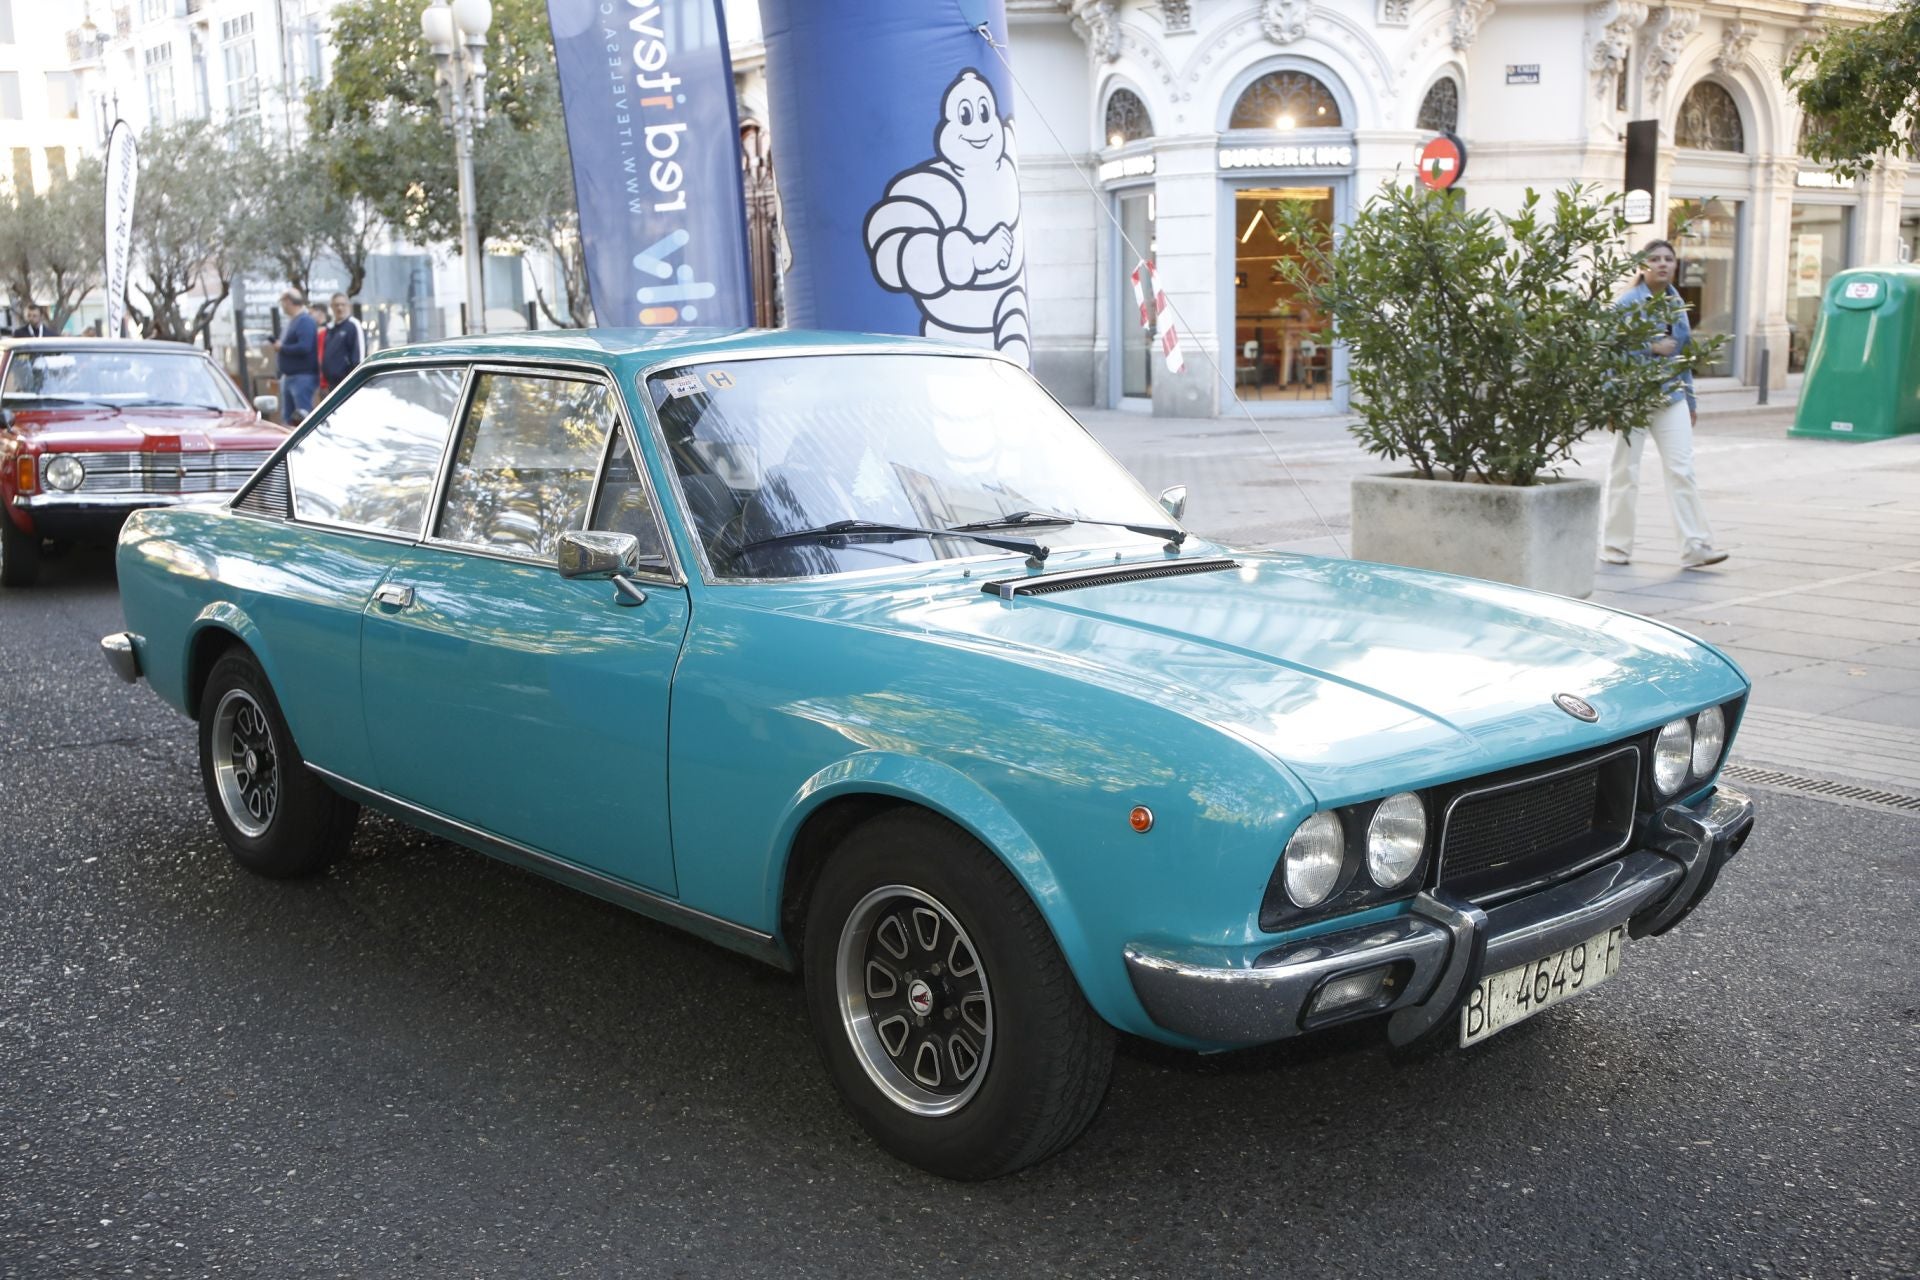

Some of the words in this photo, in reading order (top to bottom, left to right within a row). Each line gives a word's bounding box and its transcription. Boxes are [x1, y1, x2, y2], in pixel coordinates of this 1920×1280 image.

[709, 371, 733, 387] H
[1467, 978, 1492, 1038] BI
[1517, 943, 1586, 1010] 4649
[1605, 925, 1623, 974] F
